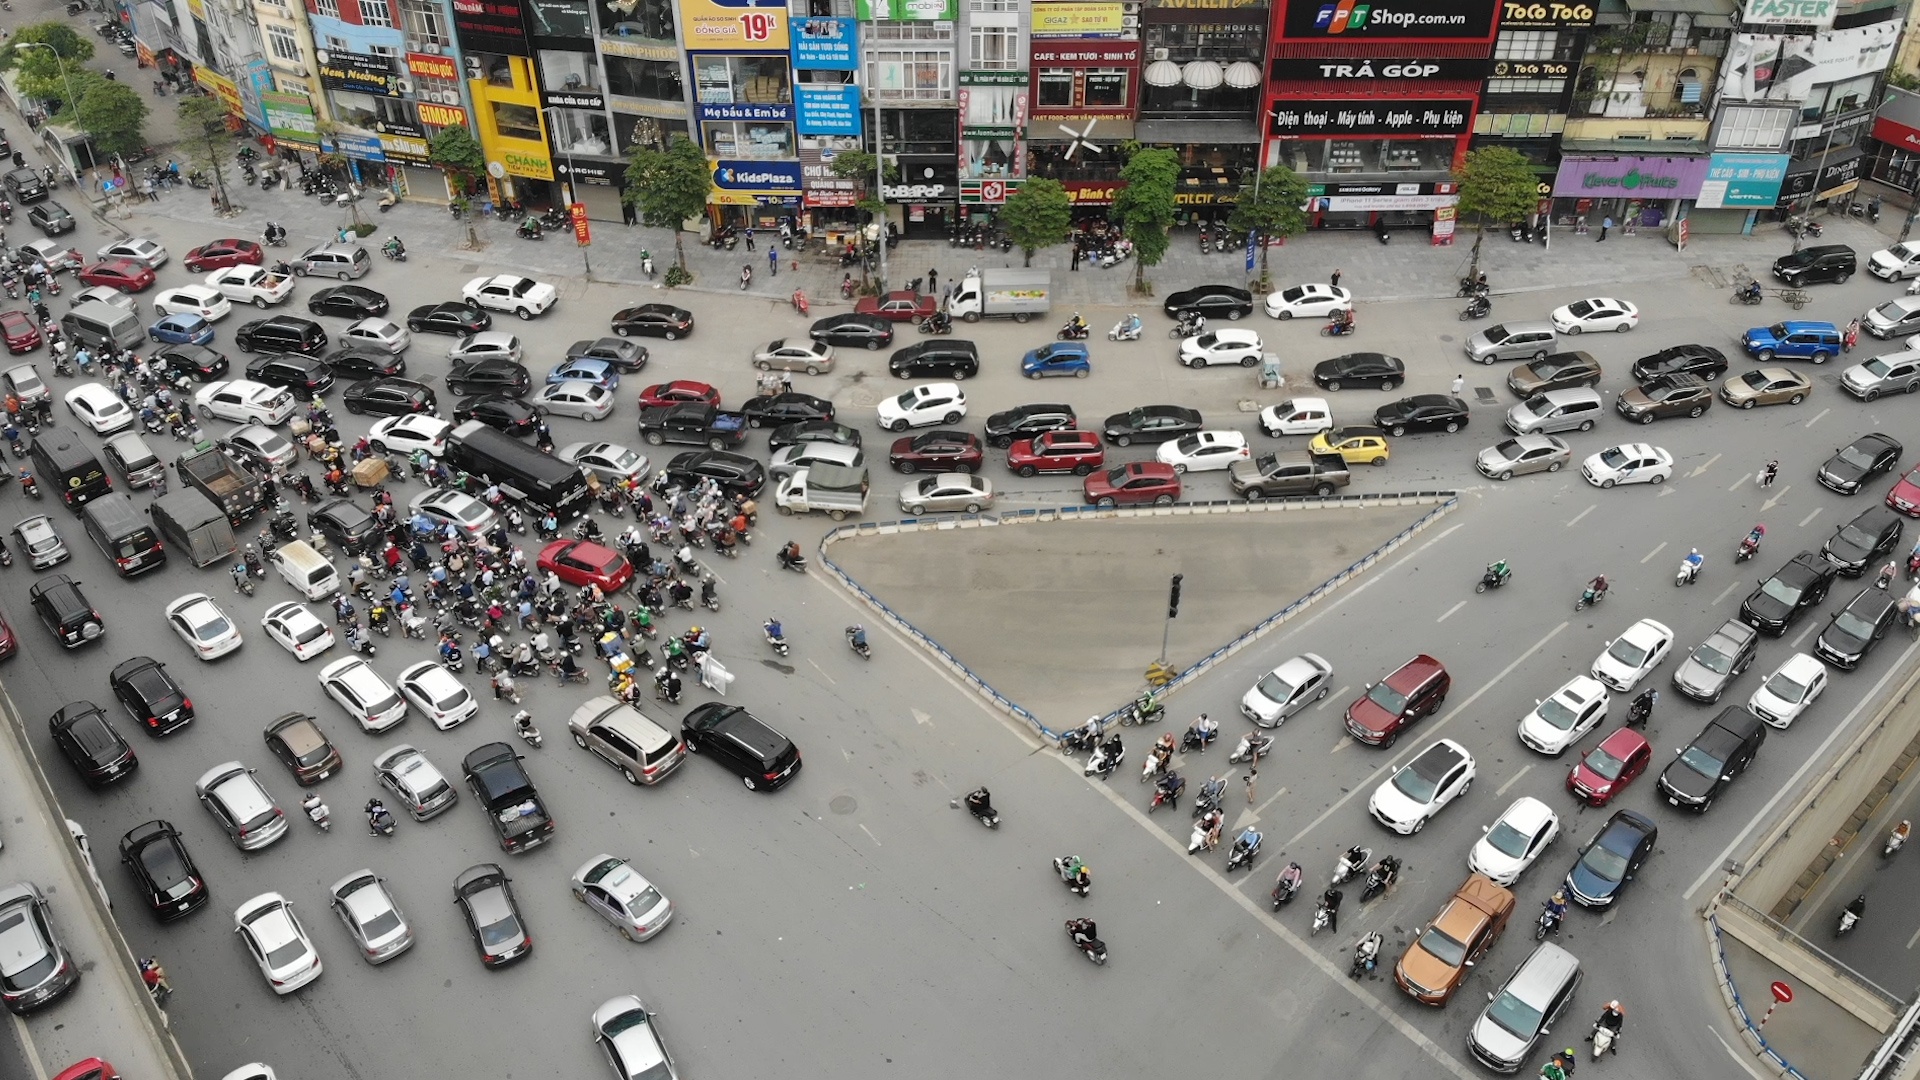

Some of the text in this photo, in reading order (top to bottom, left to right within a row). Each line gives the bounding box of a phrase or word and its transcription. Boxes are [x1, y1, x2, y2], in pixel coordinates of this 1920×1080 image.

[1750, 0, 1830, 17] FASTER
[1316, 10, 1465, 26] FPT Shop.com.vn
[1078, 52, 1098, 60] TƯƠI
[1124, 49, 1136, 60] TỐ
[320, 66, 344, 79] Nem
[1319, 60, 1439, 77] TRẢ GÓP
[418, 104, 463, 124] GIMBAP
[704, 108, 720, 119] Mẹ
[722, 106, 740, 118] bầu
[754, 109, 770, 118] Em
[771, 107, 786, 118] bé
[1277, 111, 1299, 128] Điện
[1304, 111, 1328, 128] thoại
[1337, 111, 1356, 128] Máy
[1358, 110, 1375, 124] tính
[1385, 111, 1412, 127] Apple
[1423, 111, 1439, 128] Phụ
[1443, 111, 1463, 128] kiện
[804, 165, 821, 176] CHỢ
[737, 173, 793, 183] KidsPlaza
[1079, 188, 1103, 200] Bình
